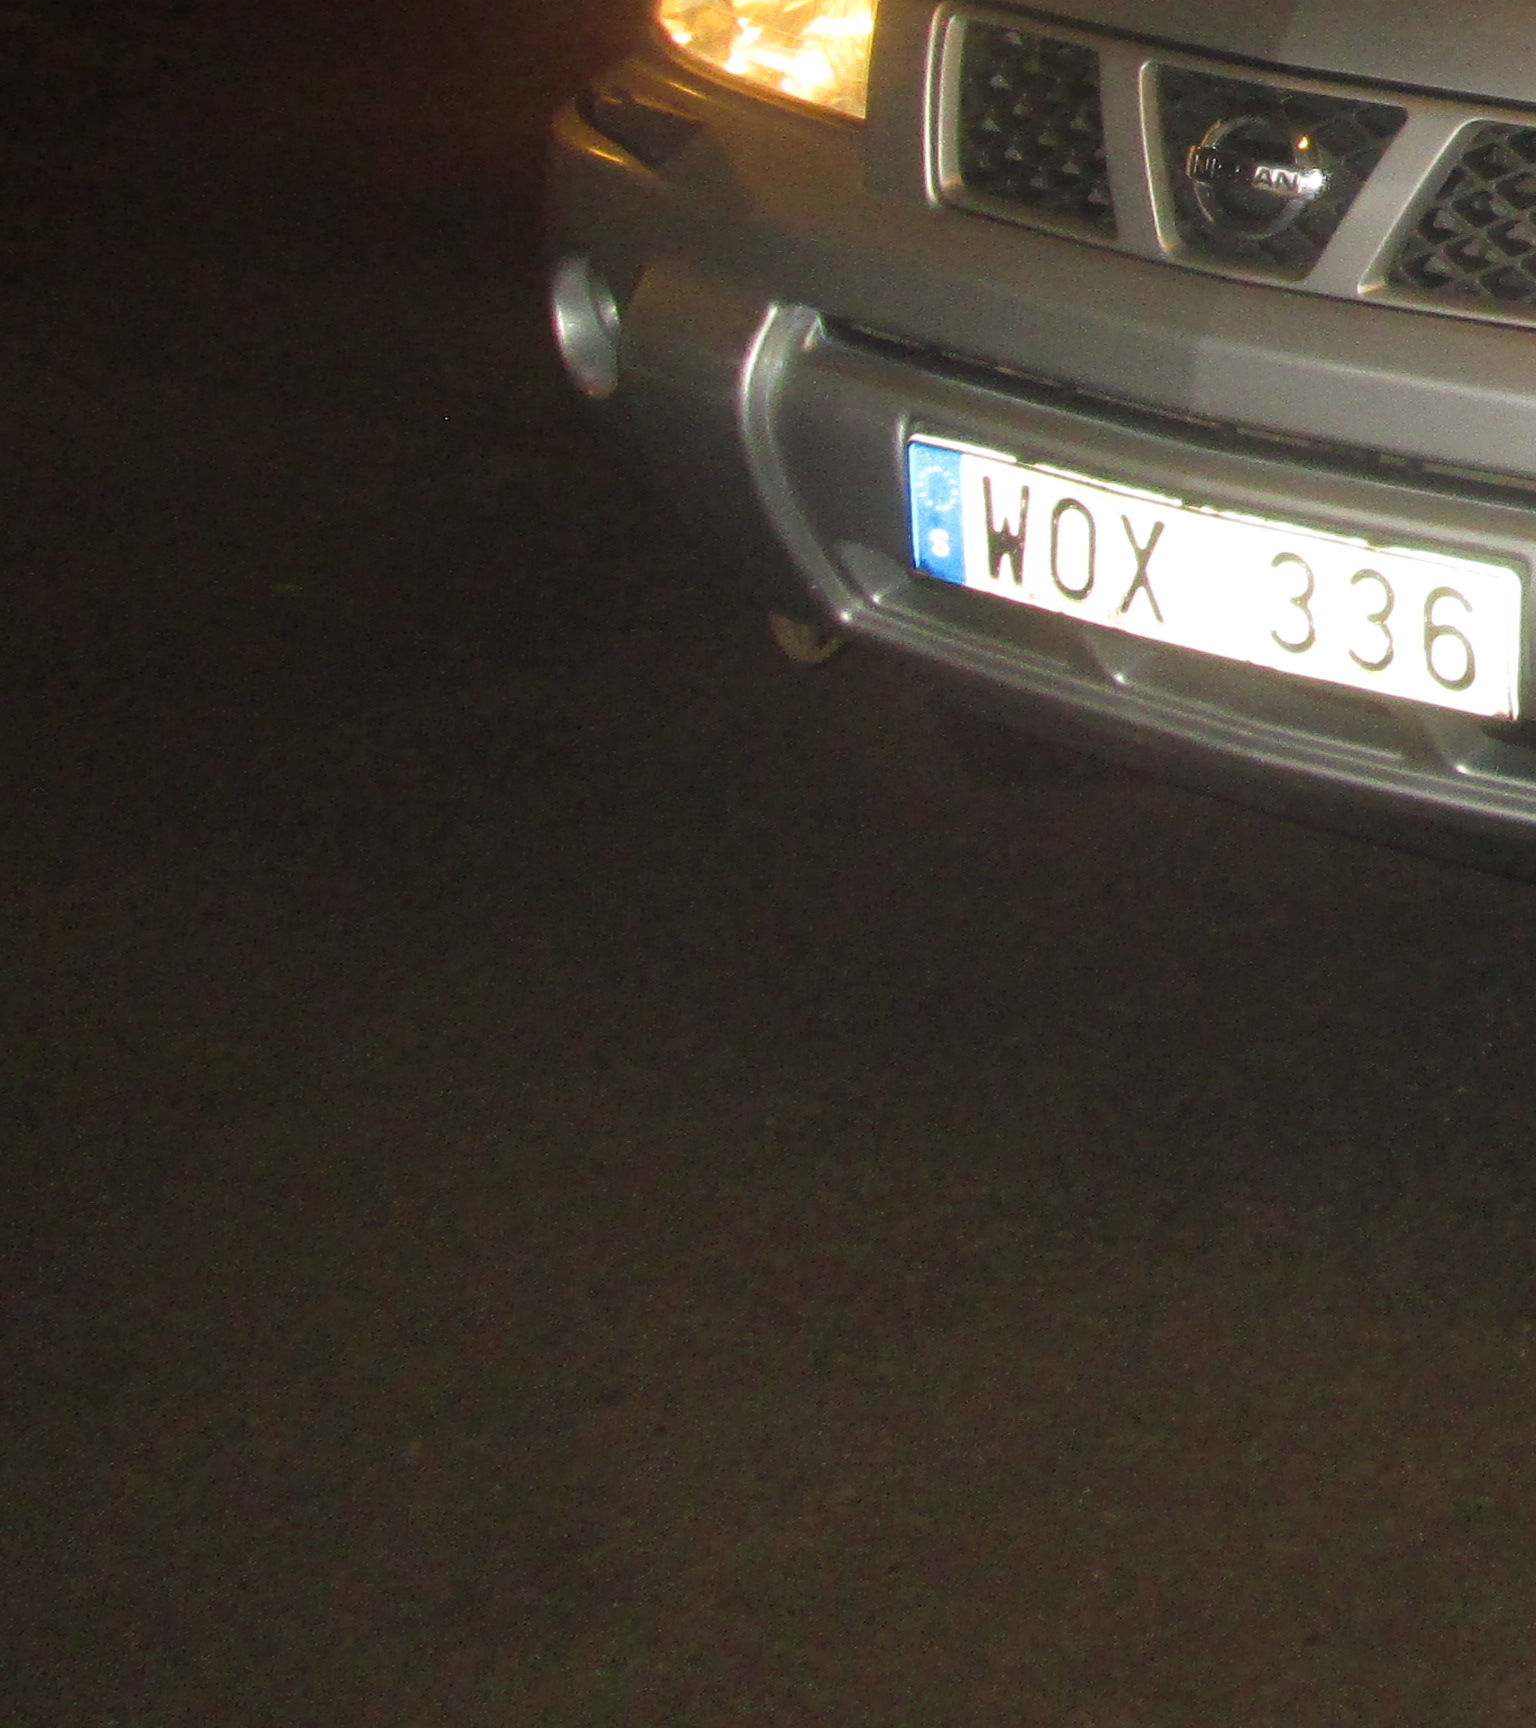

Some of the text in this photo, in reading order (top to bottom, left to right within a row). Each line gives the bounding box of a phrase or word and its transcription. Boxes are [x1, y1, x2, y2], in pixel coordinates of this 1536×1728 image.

[928, 528, 951, 558] S
[982, 475, 1477, 692] WOX 336
